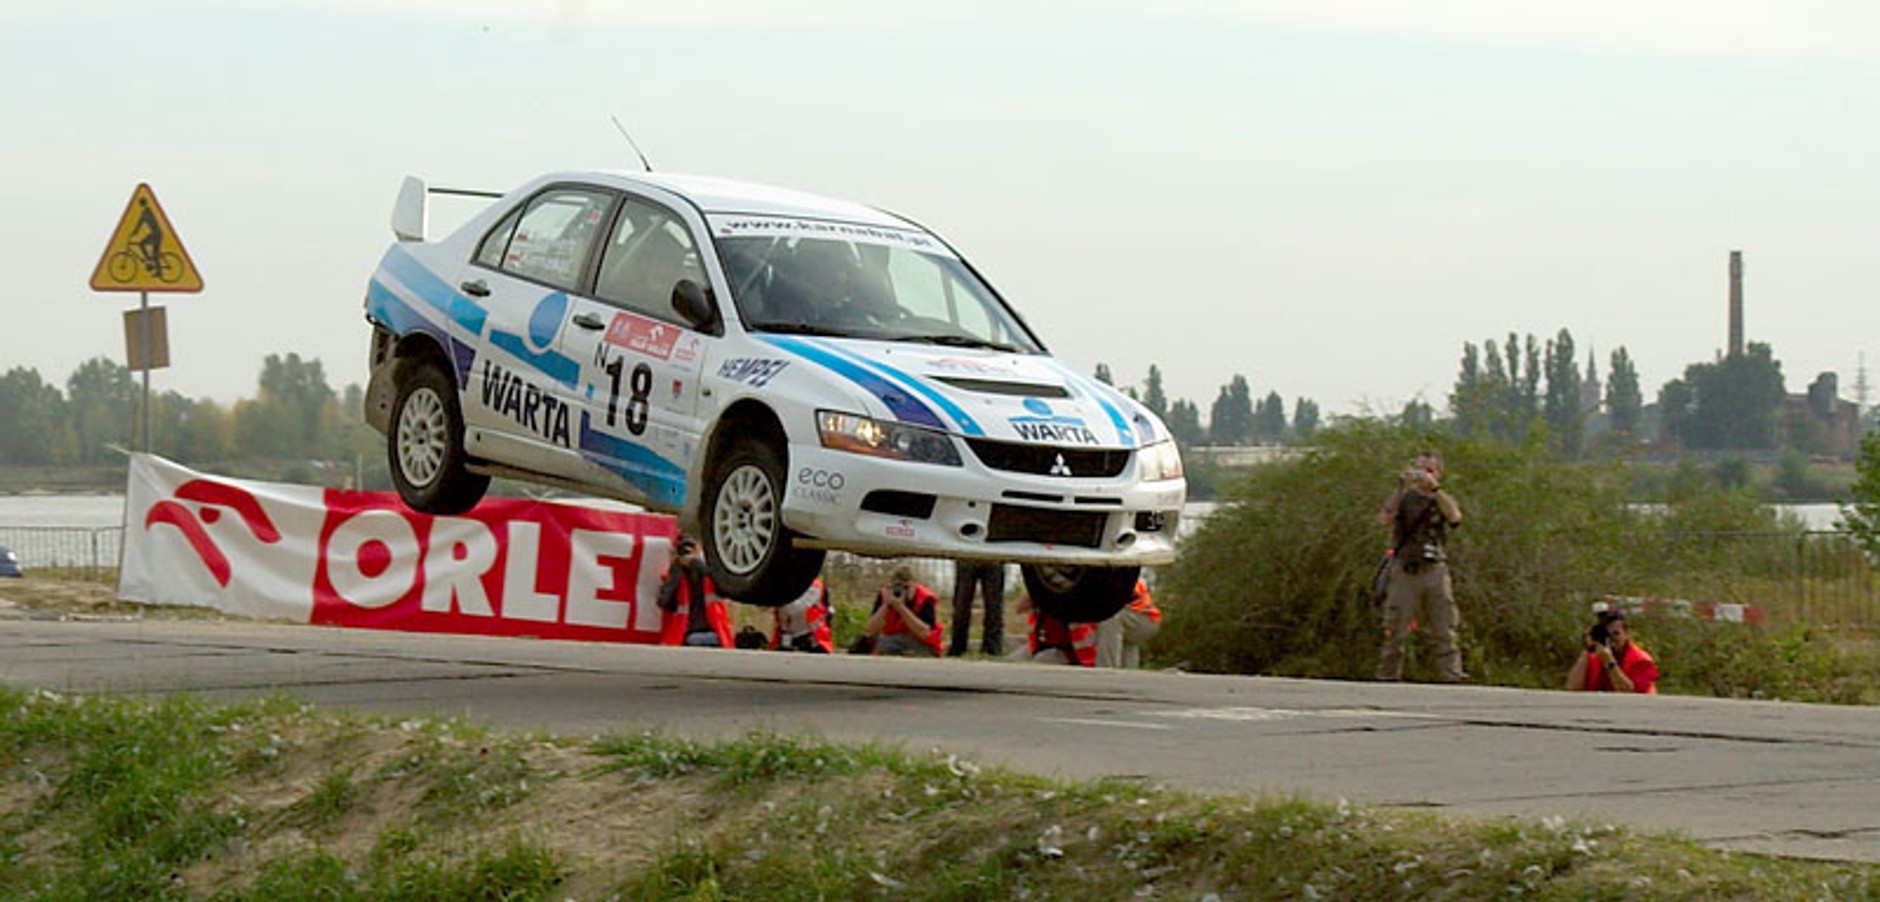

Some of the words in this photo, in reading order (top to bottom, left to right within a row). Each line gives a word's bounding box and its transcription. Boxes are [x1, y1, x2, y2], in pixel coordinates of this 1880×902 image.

[594, 342, 610, 369] N
[717, 358, 791, 389] HEMPEL
[482, 359, 571, 448] WARTA
[606, 355, 653, 436] 18
[1013, 423, 1102, 446] WARTA
[798, 467, 846, 490] eco
